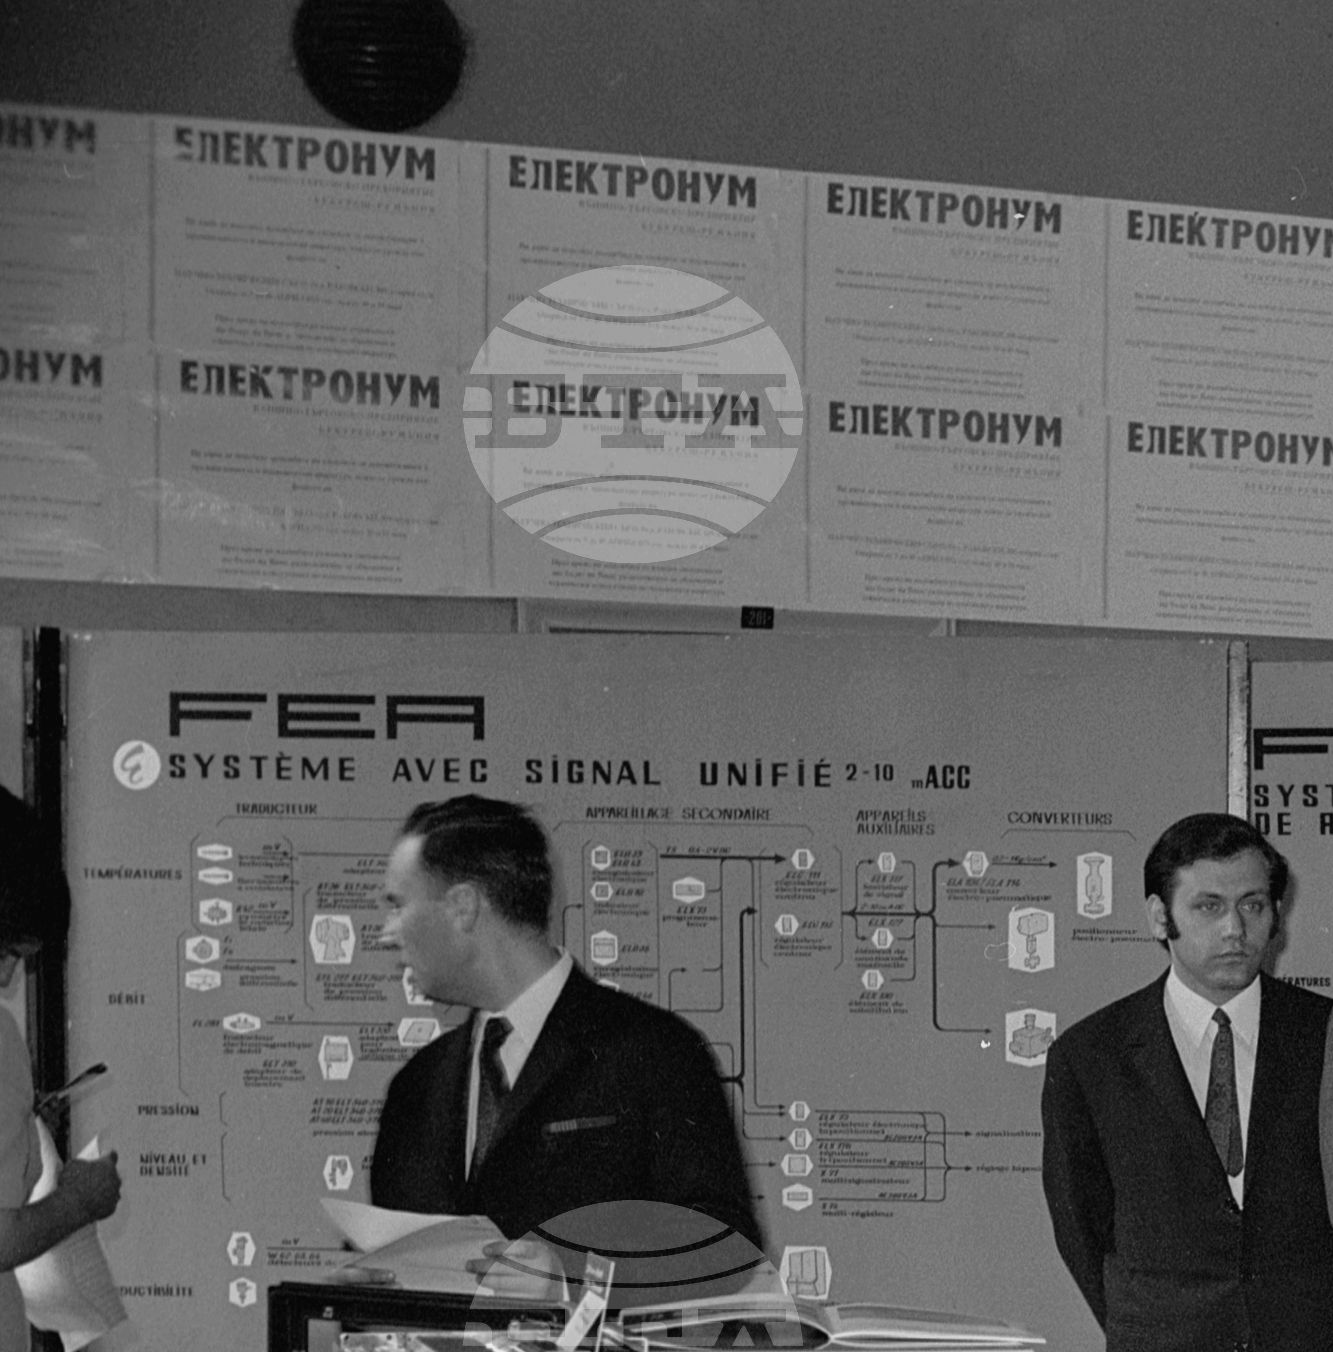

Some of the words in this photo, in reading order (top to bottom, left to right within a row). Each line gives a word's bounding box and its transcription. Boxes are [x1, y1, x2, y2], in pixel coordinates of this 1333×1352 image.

[0, 114, 95, 153] НУМ
[174, 126, 436, 182] ЕЛЕКТРОНУМ
[509, 155, 757, 209] ЕЛЕКТРОНУМ
[827, 182, 1062, 234] ЕЛЕКТРОНУМ
[180, 360, 440, 409] ЕЛЕКТРОНУМ
[512, 379, 760, 427] ЕЛЕКТРОНУМ
[828, 400, 1063, 448] ЕЛЕКТРОНУМ
[169, 691, 485, 740] FEA
[169, 750, 357, 782] SYSTÈME
[392, 757, 489, 784] AVEC
[235, 802, 318, 816] TRADUCTEUR
[1006, 810, 1113, 827] CONVERTEURS
[1254, 811, 1293, 836] DE
[83, 864, 183, 881] TEMPÉRATURES
